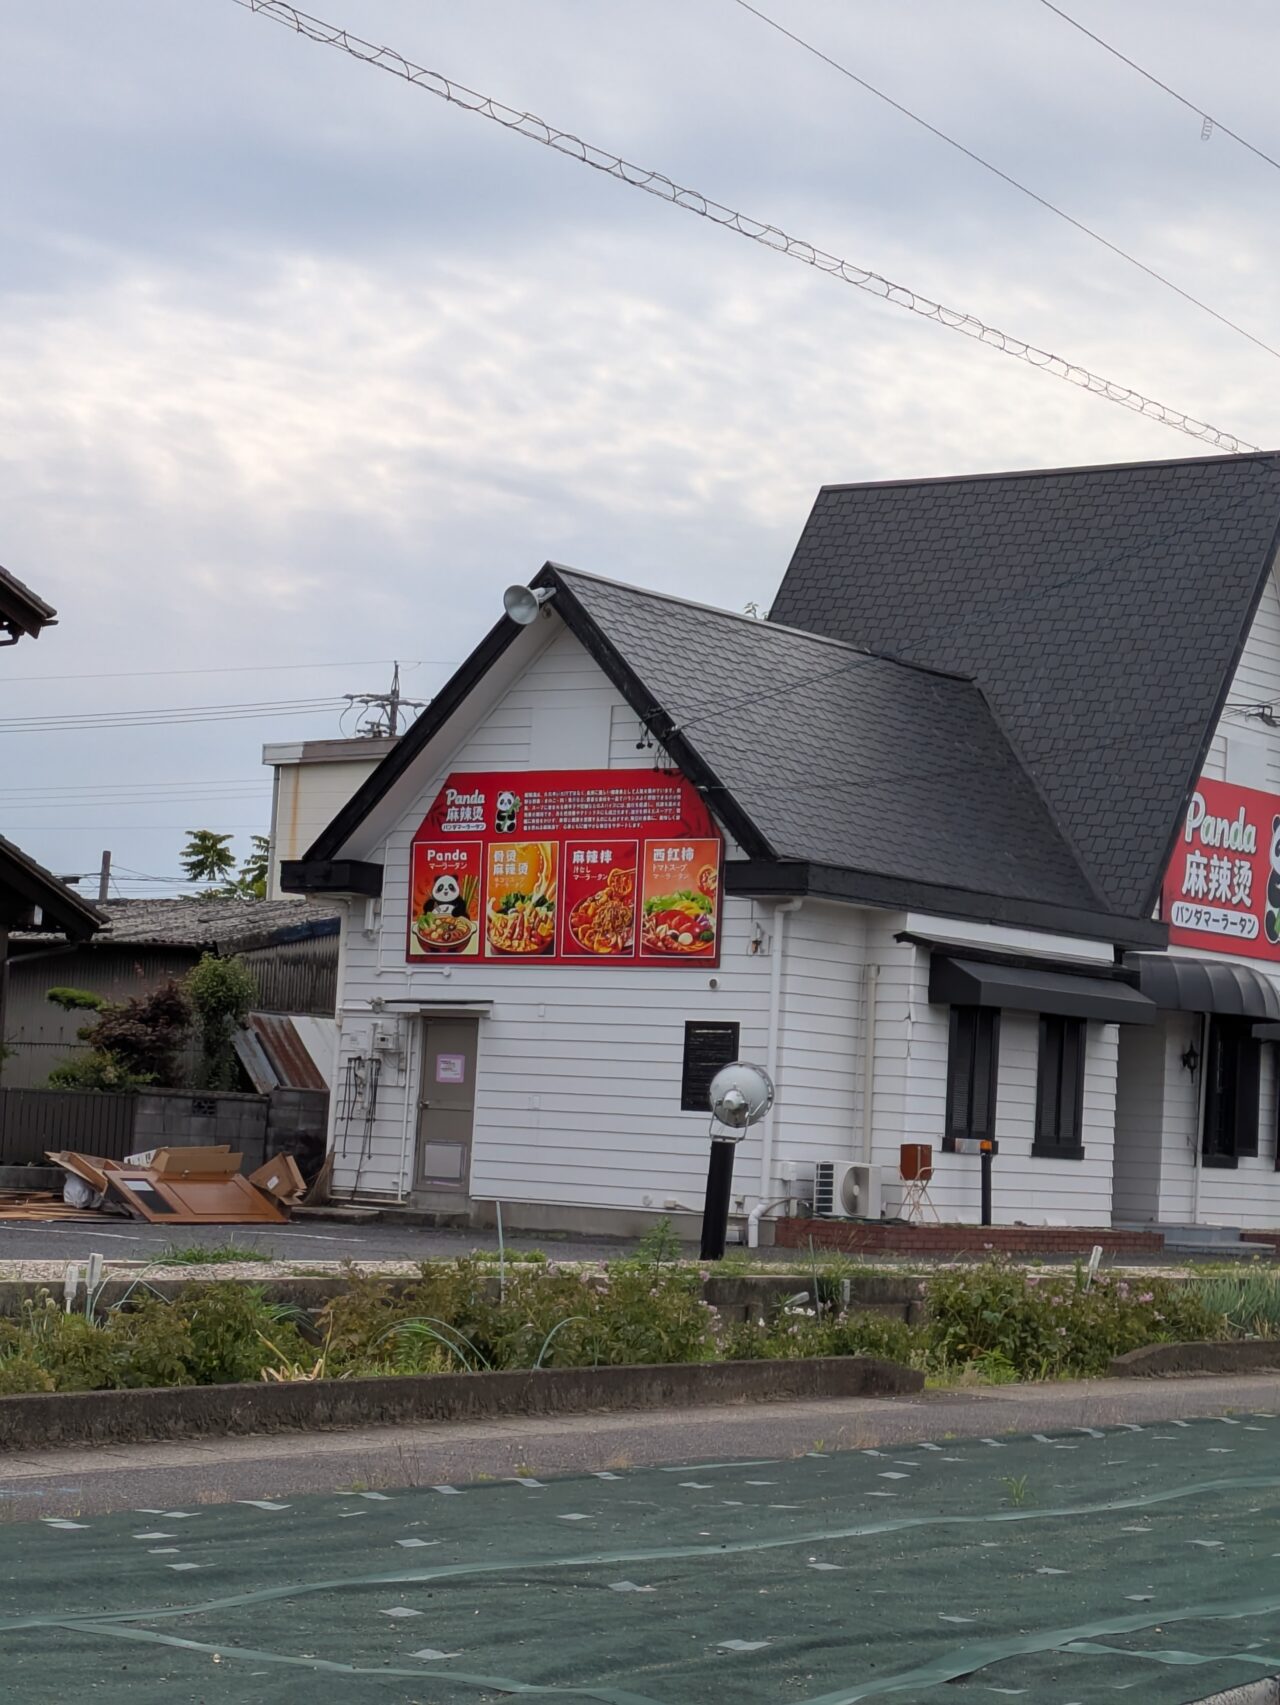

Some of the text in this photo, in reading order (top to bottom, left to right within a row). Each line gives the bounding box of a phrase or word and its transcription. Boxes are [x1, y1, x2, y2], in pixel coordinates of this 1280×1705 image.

[446, 788, 485, 806] Panda
[1185, 792, 1257, 854] Panda
[427, 849, 467, 861] Panda
[1182, 850, 1253, 907] 麻辣烫
